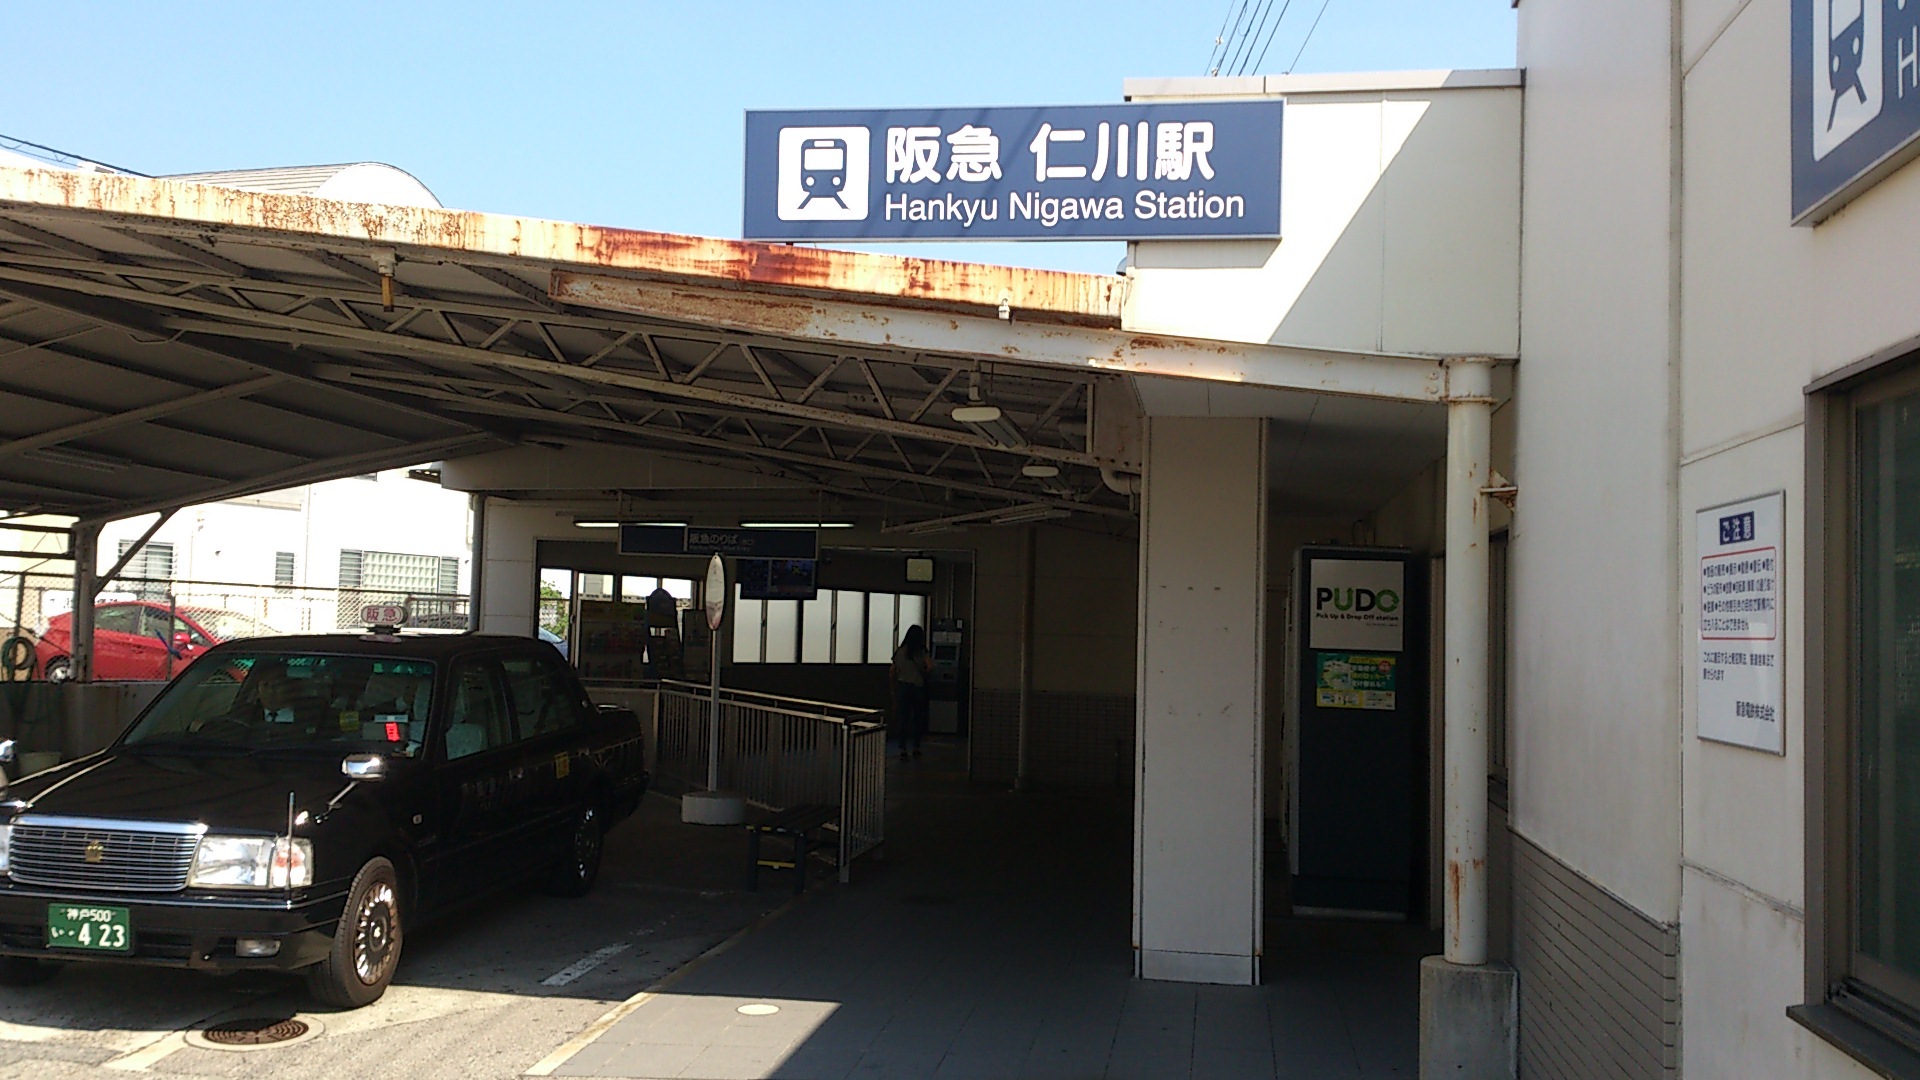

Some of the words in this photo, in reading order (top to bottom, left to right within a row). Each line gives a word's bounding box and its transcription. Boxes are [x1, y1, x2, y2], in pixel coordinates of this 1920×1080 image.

[885, 123, 1002, 184] 阪急
[1030, 121, 1215, 183] 仁川駅
[884, 193, 998, 228] Hankyu
[1009, 193, 1124, 227] Nigawa
[1135, 190, 1245, 219] Station
[1722, 515, 1752, 542] ご注意
[1316, 587, 1399, 612] PUDO
[366, 607, 398, 622] 阪急
